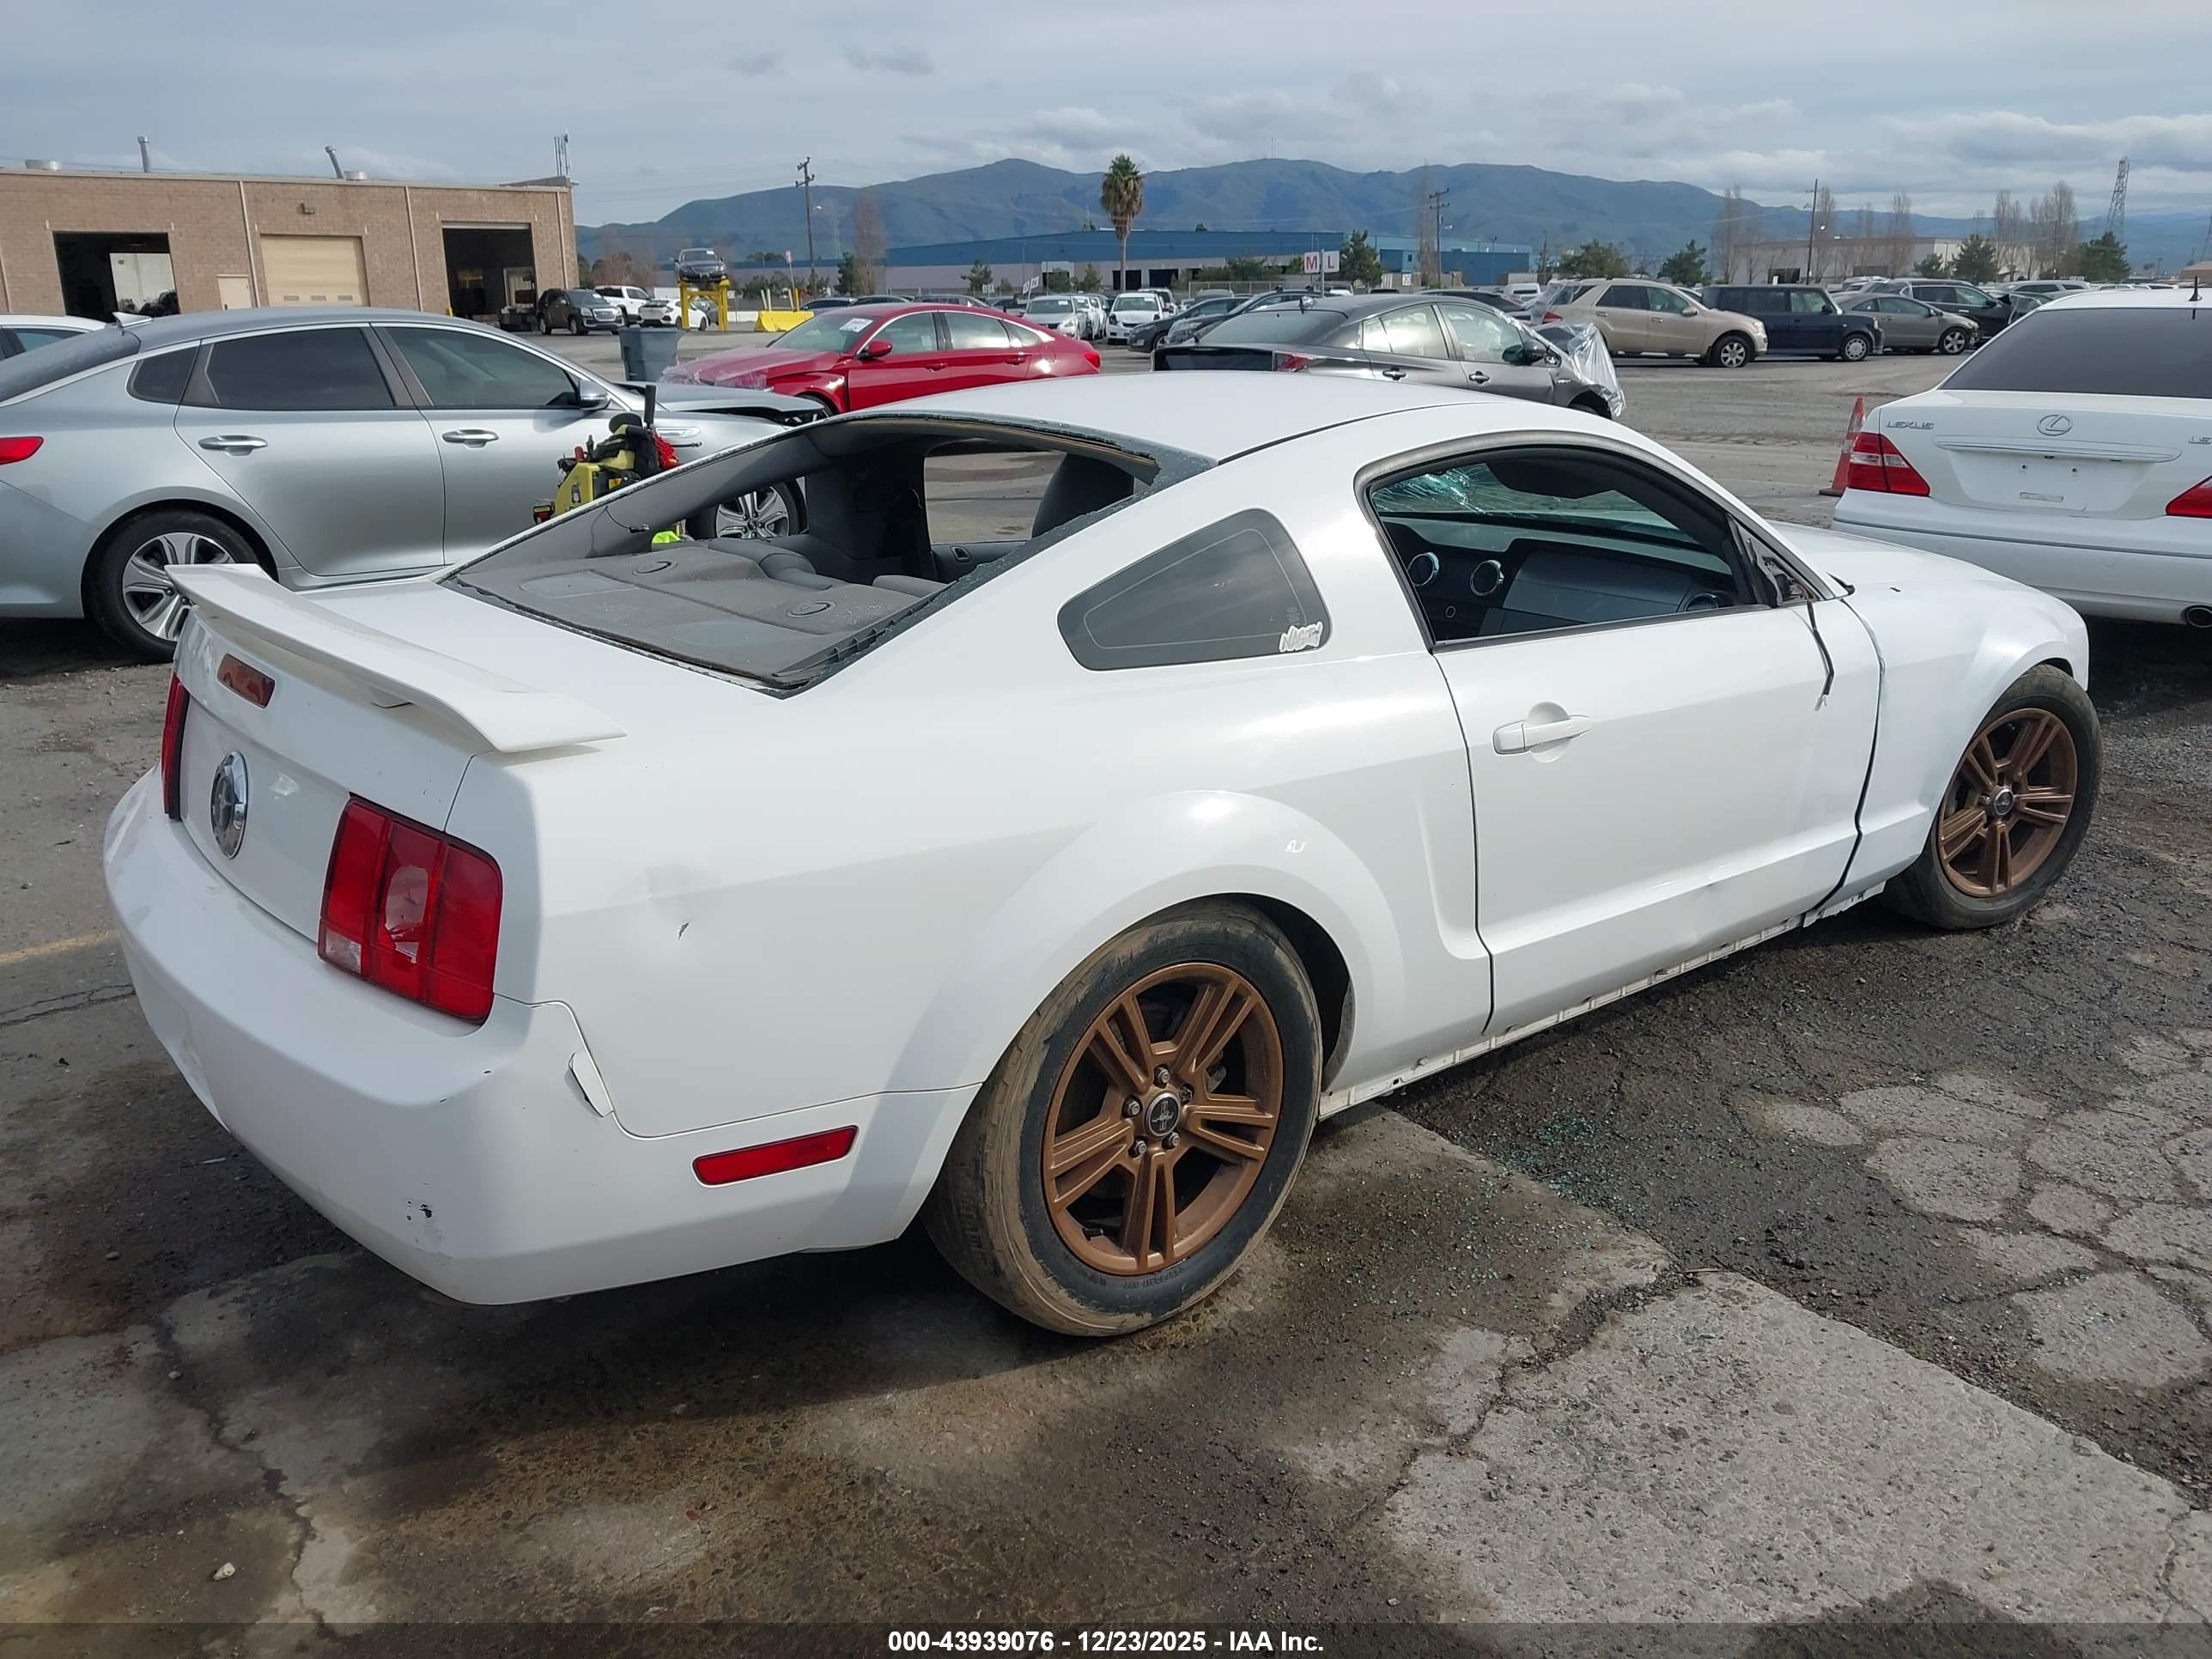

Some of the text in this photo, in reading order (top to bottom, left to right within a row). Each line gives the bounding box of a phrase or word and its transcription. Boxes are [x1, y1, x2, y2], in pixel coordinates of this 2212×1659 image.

[1306, 255, 1334, 269] M L
[1887, 421, 1934, 429] LEXUS
